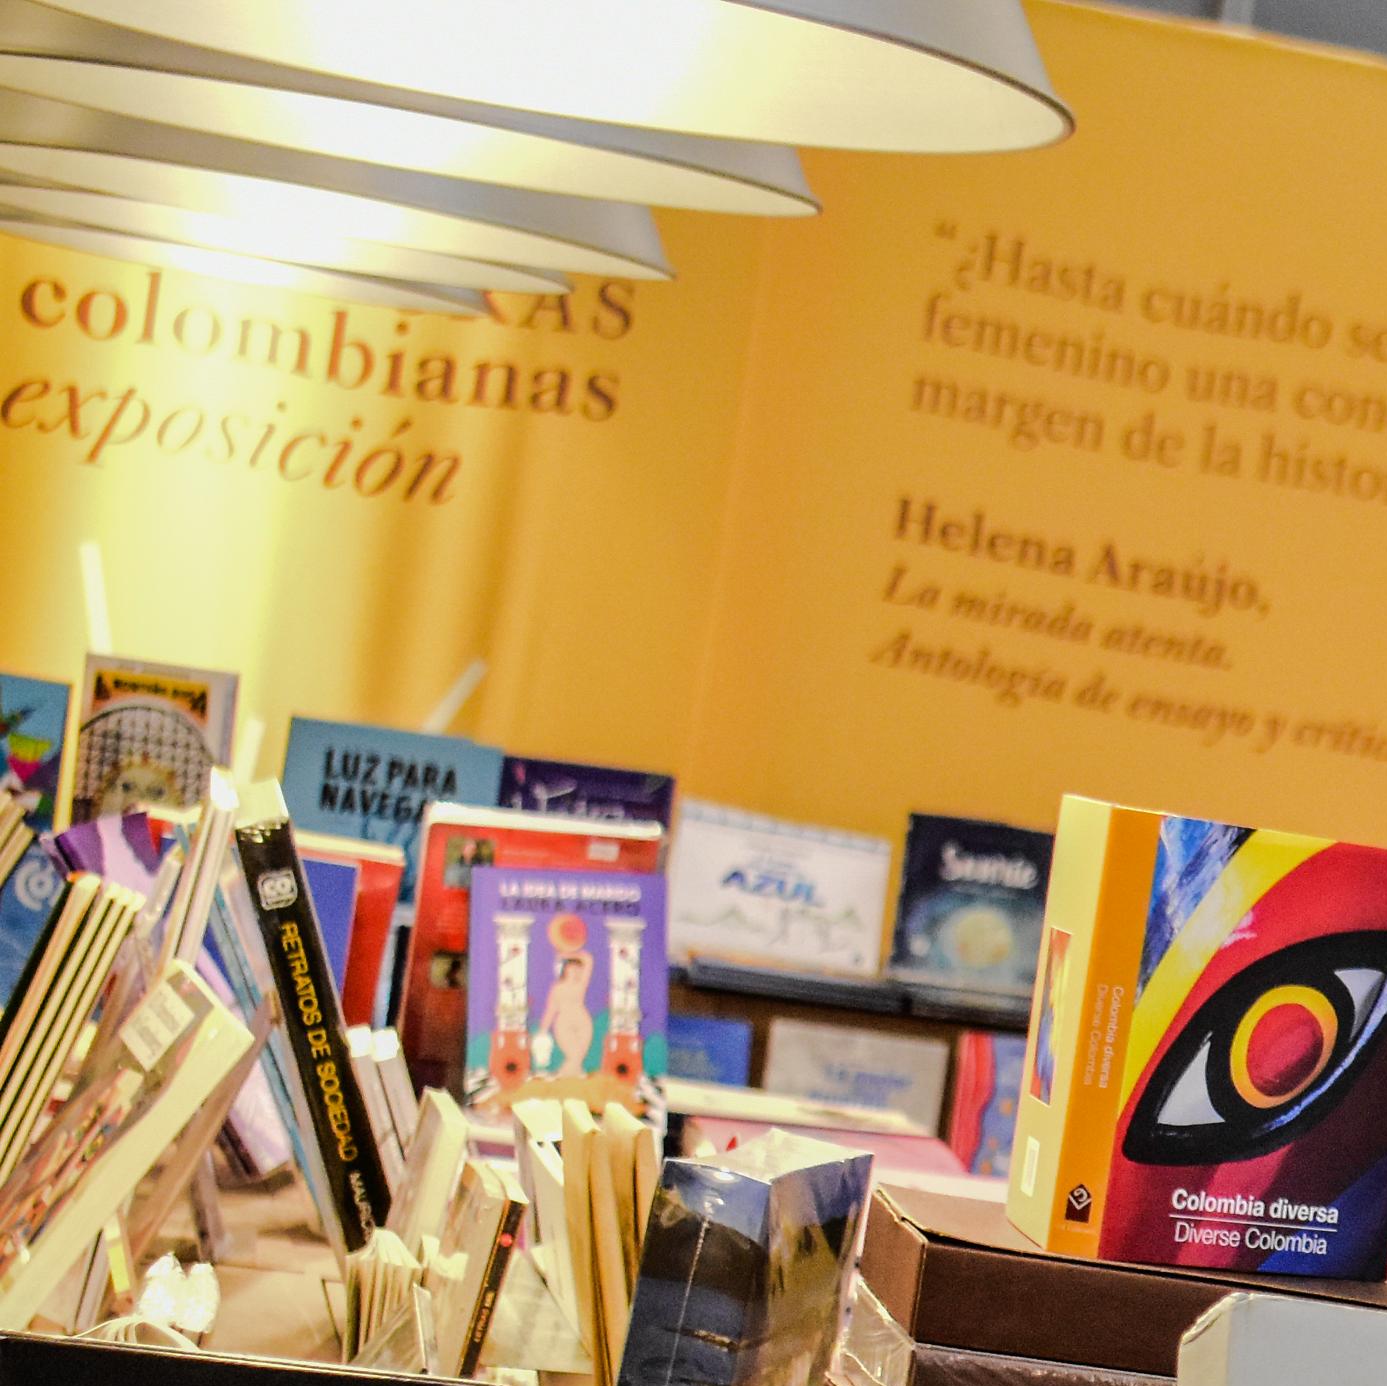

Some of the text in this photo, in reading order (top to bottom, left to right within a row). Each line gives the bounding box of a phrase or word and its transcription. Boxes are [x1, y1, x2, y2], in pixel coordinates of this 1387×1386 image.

[21, 271, 621, 423] colombianas
[923, 293, 1169, 395] femenino
[1185, 364, 1278, 414] una
[1141, 282, 1332, 350] cuándo
[0, 376, 464, 507] exposición
[912, 371, 1104, 454] margen
[1123, 414, 1185, 469] de
[1202, 423, 1242, 479] la
[884, 565, 941, 615] La
[951, 575, 1092, 645] mirada
[893, 494, 1271, 618] Helena Araújo,
[872, 630, 1066, 710] Antología
[1073, 669, 1120, 717] de
[1127, 691, 1254, 742] ensayo
[1260, 710, 1287, 755] y
[323, 745, 459, 798] LUZ PARA
[280, 920, 358, 1163] RETRATOS DE SOCIEDAD
[1105, 985, 1125, 1043] Colombia
[1171, 1188, 1338, 1224] Colombia diversa
[1174, 1221, 1328, 1256] Diverse Colombia
